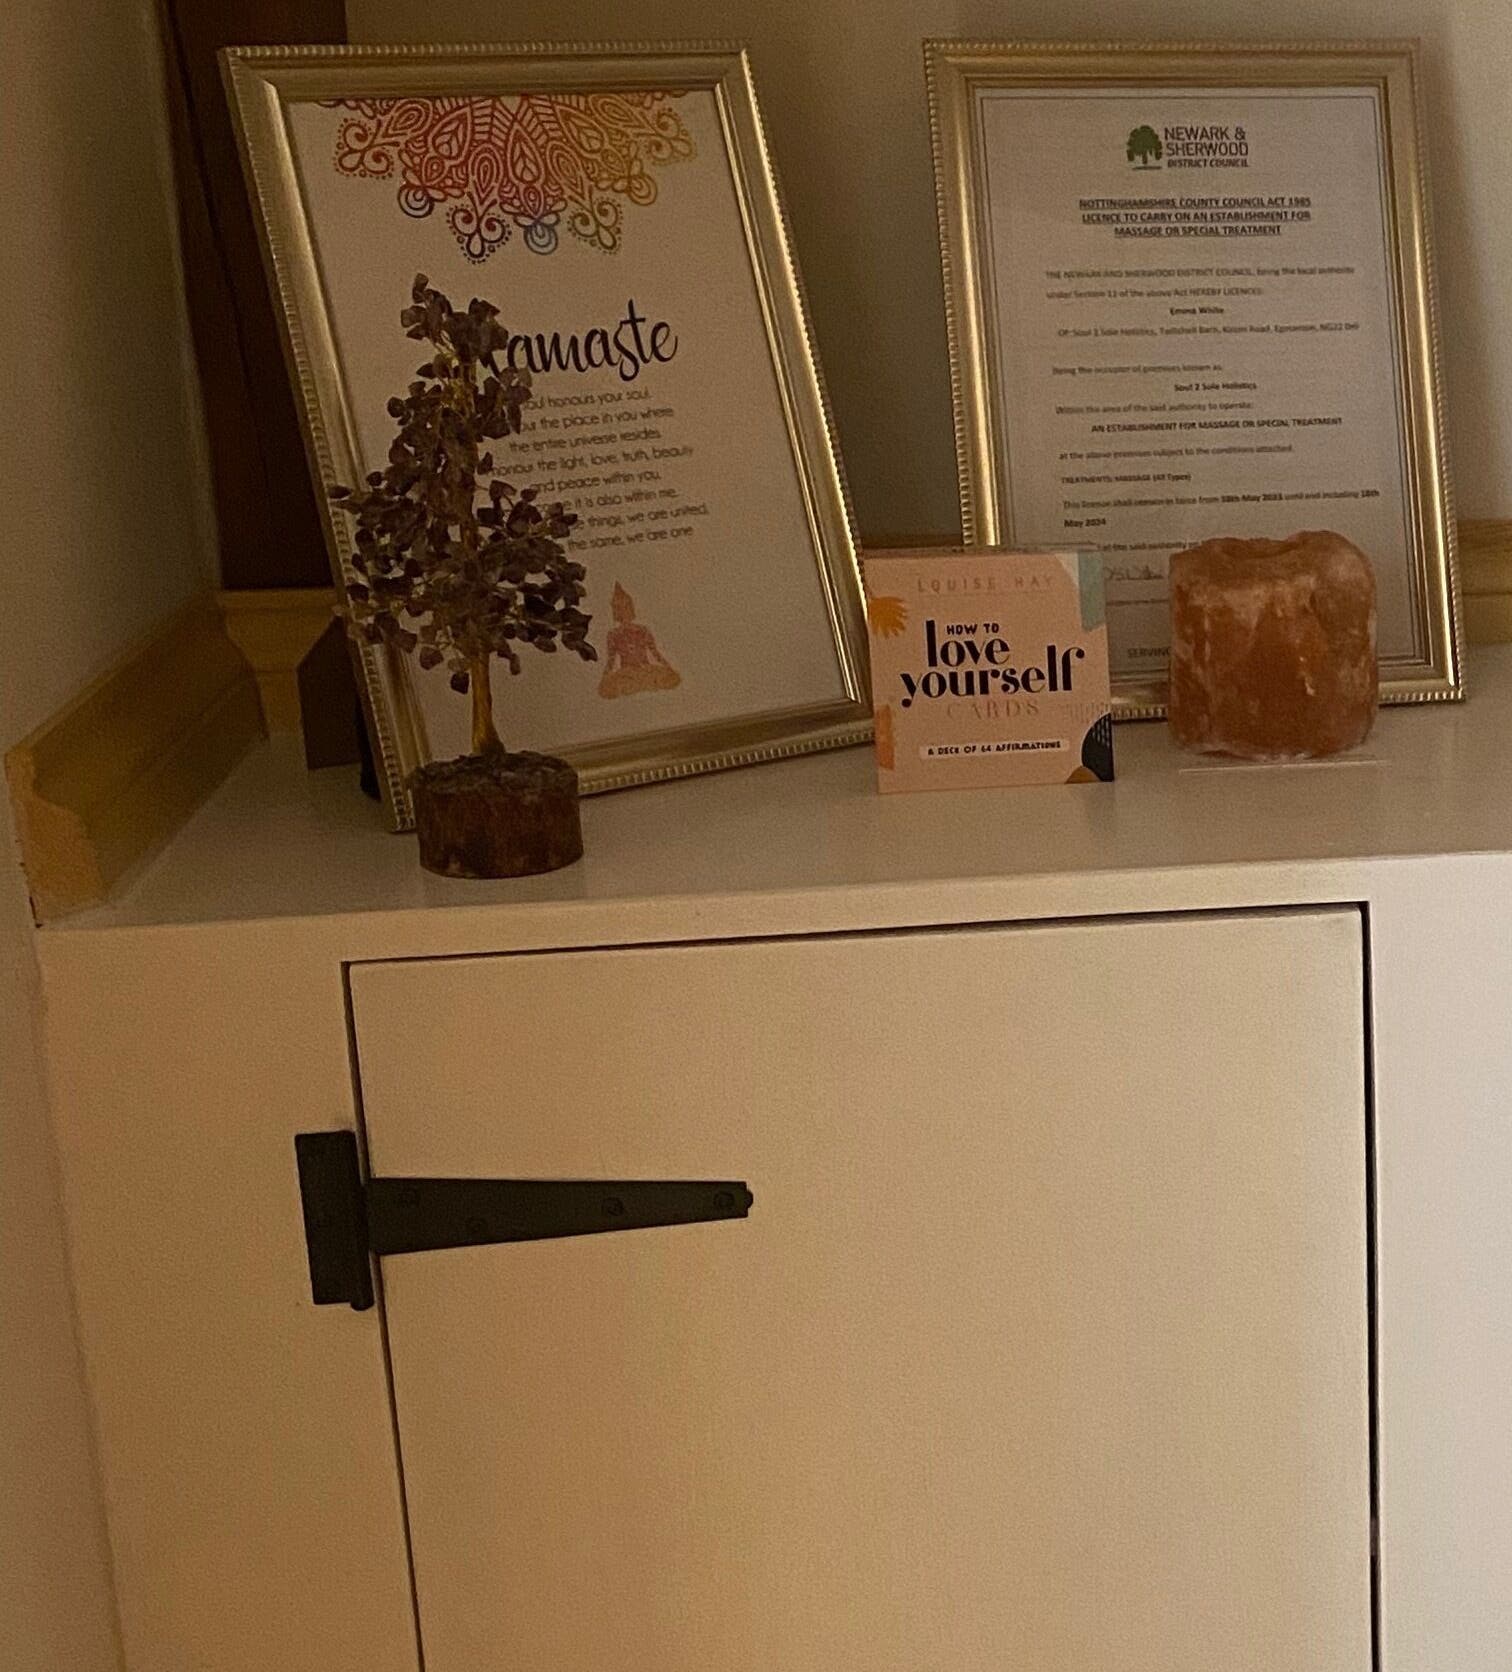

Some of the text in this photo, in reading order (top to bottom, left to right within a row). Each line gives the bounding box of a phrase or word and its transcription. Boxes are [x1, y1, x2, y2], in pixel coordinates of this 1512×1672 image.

[1165, 126, 1246, 141] NEWARK &
[1166, 141, 1248, 156] SHERWOOD
[1167, 158, 1249, 168] DISTRICT COUNCIL
[1079, 197, 1311, 209] NOTTINGHAMSHIRE COUNTY COUNCIL ACT 1985
[1082, 211, 1311, 224] LICENCE TO CARRY ON AN ESTABLISHMENT FOR
[1115, 225, 1281, 237] MASSAGE OR SPECIAL TREATMENT
[484, 298, 678, 381] amaste
[547, 394, 595, 408] honours
[598, 391, 623, 405] your
[540, 416, 560, 429] the
[563, 413, 600, 429] place
[602, 412, 613, 424] in
[615, 411, 637, 422] you
[640, 406, 674, 419] where
[1091, 417, 1343, 433] AN ESTABLISHMENT FOR MASSAGE OR SPECIAL TREATMENT
[509, 441, 530, 453] the
[569, 432, 617, 448] universe
[537, 459, 556, 471] the
[557, 476, 601, 492] peace
[596, 494, 622, 506] also
[1241, 493, 1261, 503] May
[627, 512, 645, 522] we
[647, 510, 668, 521] are
[1064, 518, 1084, 529] May
[627, 532, 644, 543] we
[647, 530, 668, 541] are
[1014, 574, 1053, 589] HAY
[946, 621, 1000, 636] HOW TO
[926, 619, 1010, 667] love
[900, 644, 1085, 708] yourself
[946, 700, 1040, 720] CARDS
[927, 747, 935, 756] A
[938, 746, 960, 755] DECK
[963, 745, 977, 754] OF
[995, 740, 1061, 752] AFFIRMATIONS
